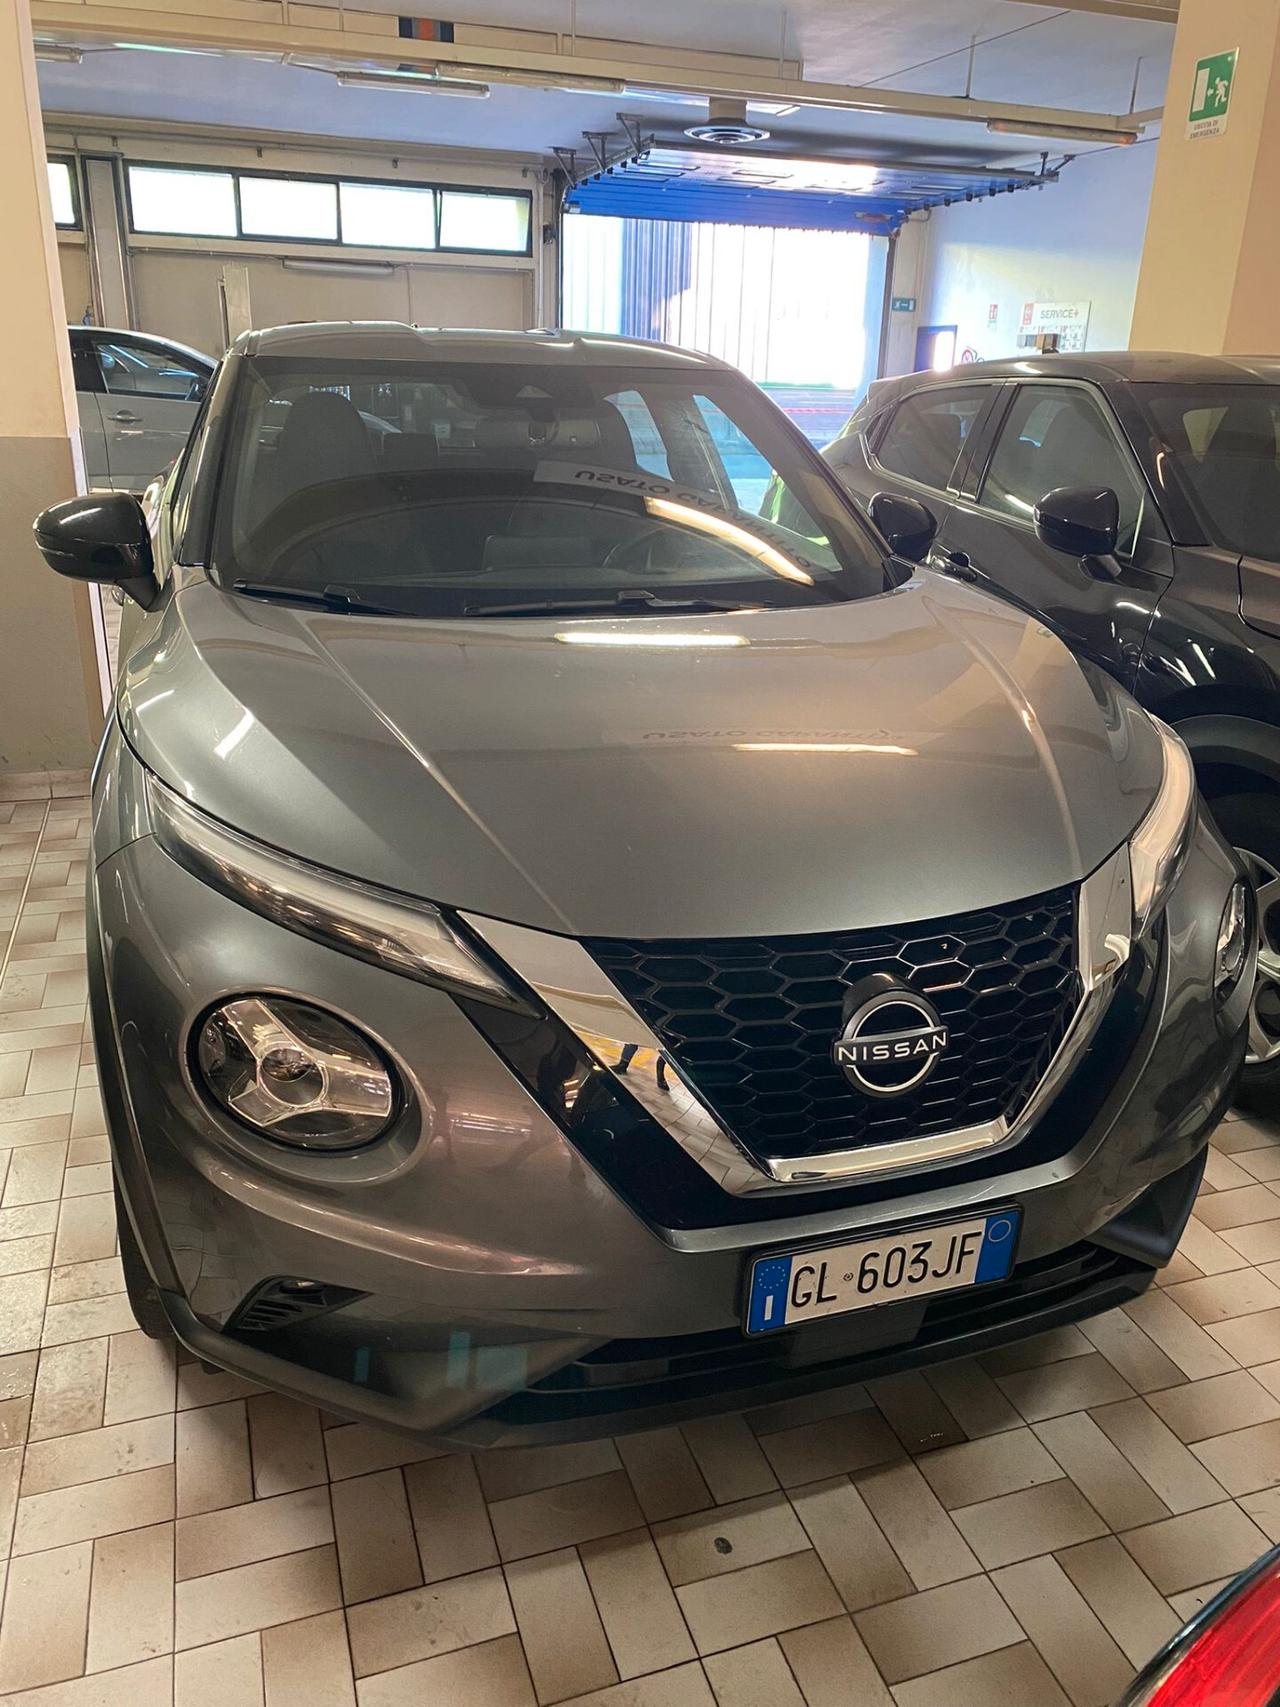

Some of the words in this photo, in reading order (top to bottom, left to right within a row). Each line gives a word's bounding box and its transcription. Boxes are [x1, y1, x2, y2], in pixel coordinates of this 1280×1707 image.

[838, 1031, 947, 1061] NISSAN
[791, 1262, 837, 1308] GL
[856, 1231, 982, 1294] 603JF
